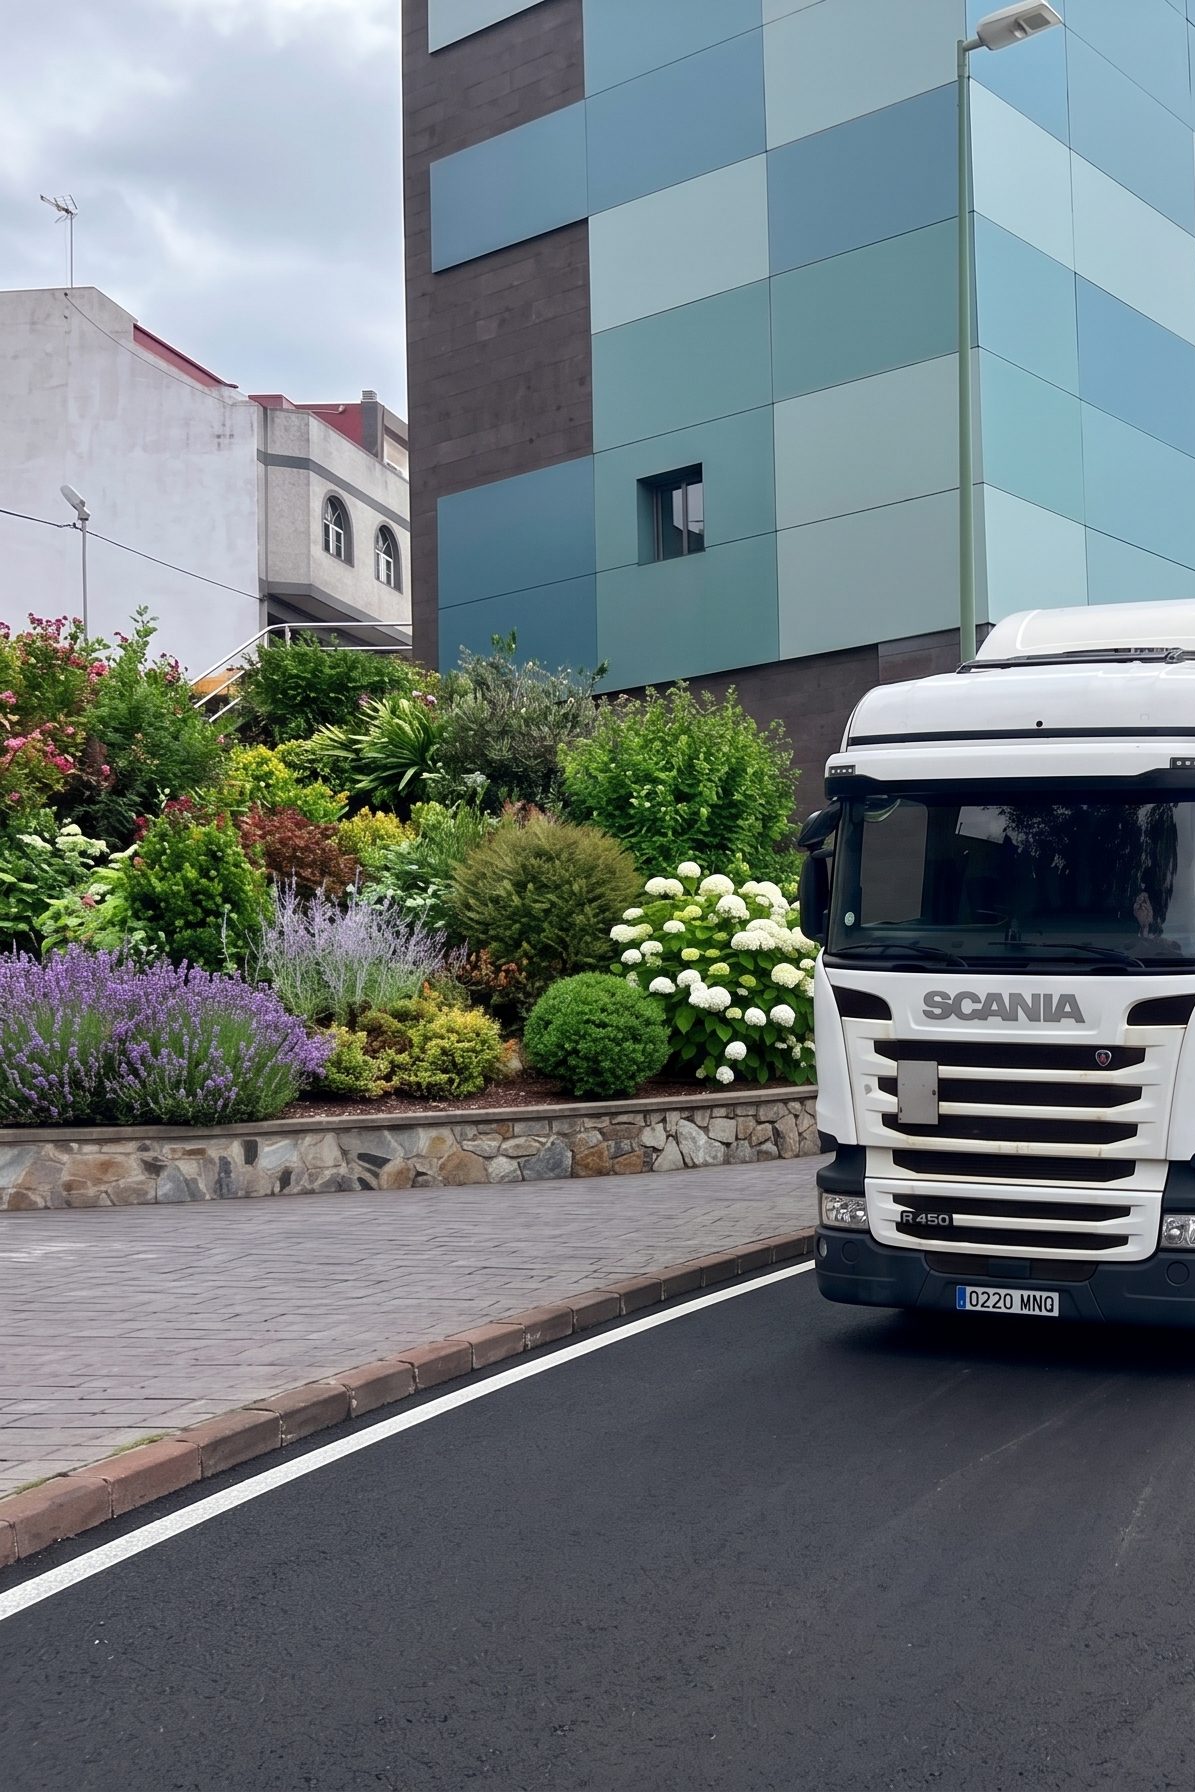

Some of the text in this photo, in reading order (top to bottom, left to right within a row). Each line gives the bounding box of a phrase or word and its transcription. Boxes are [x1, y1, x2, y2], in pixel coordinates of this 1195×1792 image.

[922, 990, 1086, 1023] SCANIA
[902, 1213, 949, 1225] R 450
[969, 1290, 1054, 1313] 0220 MNQ
